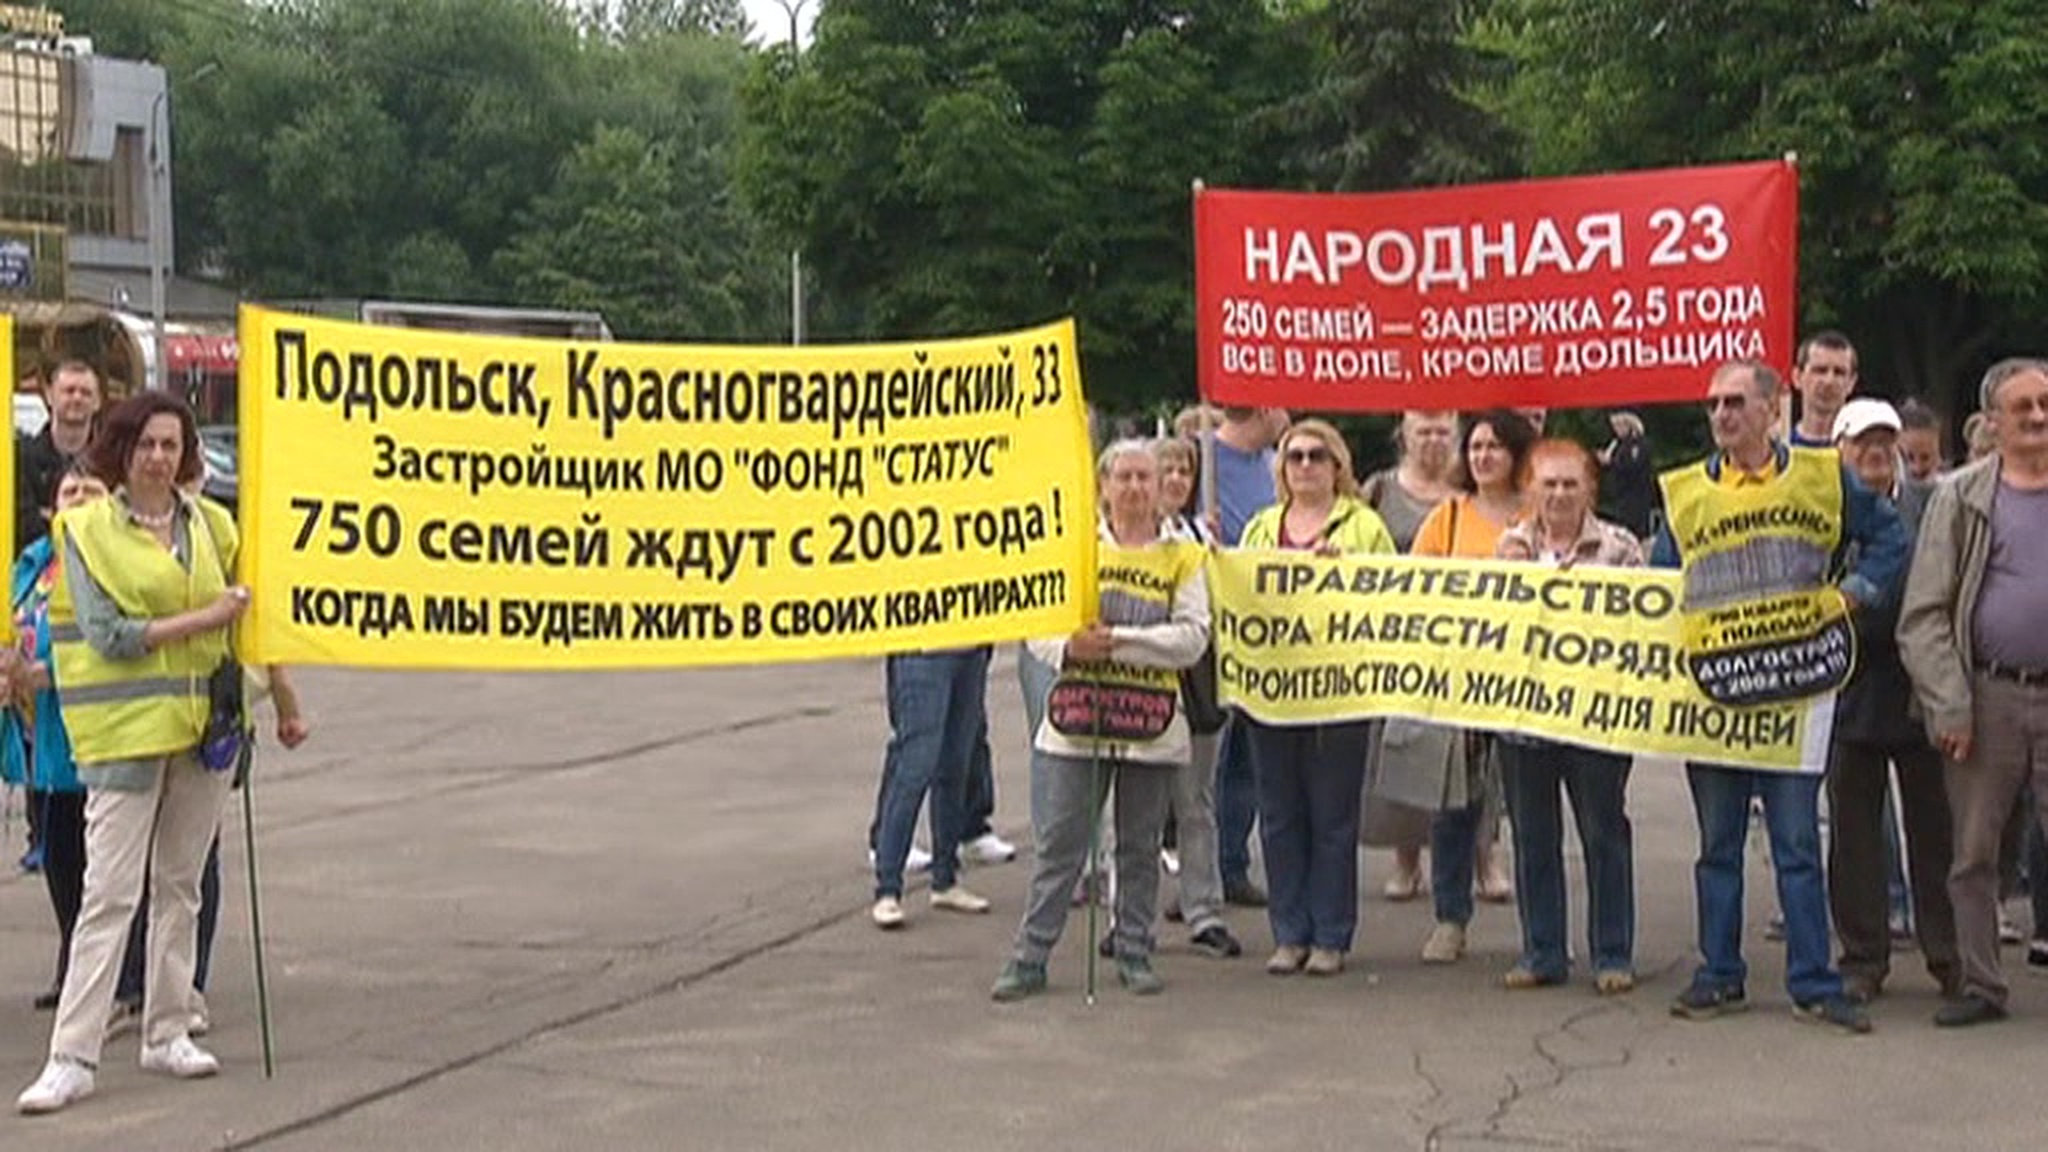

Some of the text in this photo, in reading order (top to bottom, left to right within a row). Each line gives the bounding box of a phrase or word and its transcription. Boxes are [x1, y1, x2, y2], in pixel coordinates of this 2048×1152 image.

[1244, 204, 1730, 294] НАРОДНАЯ 23
[1222, 299, 1268, 338] 250
[1274, 304, 1375, 340] СЕМЕЙ
[1420, 297, 1603, 344] ЗАДЕРЖКА
[1611, 286, 1668, 332] 2,5
[1677, 283, 1766, 326] ГОДА
[274, 329, 1063, 440] Подольск, Красногвардейский, 33
[1222, 328, 1767, 382] ВСЕ В ДОЛЕ, КРОМЕ ДОЛЬЩИКА
[372, 434, 1010, 498] Застройщик МО "ФОНД "СТАТУС"
[290, 497, 402, 558] 750
[417, 512, 609, 567] семей
[626, 527, 776, 583] ждут
[788, 525, 815, 566] с
[828, 506, 943, 565] 2002
[955, 501, 1046, 556] года
[291, 569, 1067, 647] КОГДА МЫ БУДЕМ ЖИТЬ В СВОИХ КВАРТИРАХ???
[1255, 563, 1675, 620] ПРАВИТЕЛЬСТВО
[1220, 608, 1312, 648] ПОРА
[1326, 612, 1510, 656] НАВЕСТИ
[1220, 652, 1451, 702] СТРОИТЕЛЬСТВОМ
[1462, 670, 1575, 719] ЖИЛЬЯ
[1582, 691, 1653, 733] ДЛЯ
[1664, 698, 1797, 750] ЛЮДЕЙ
